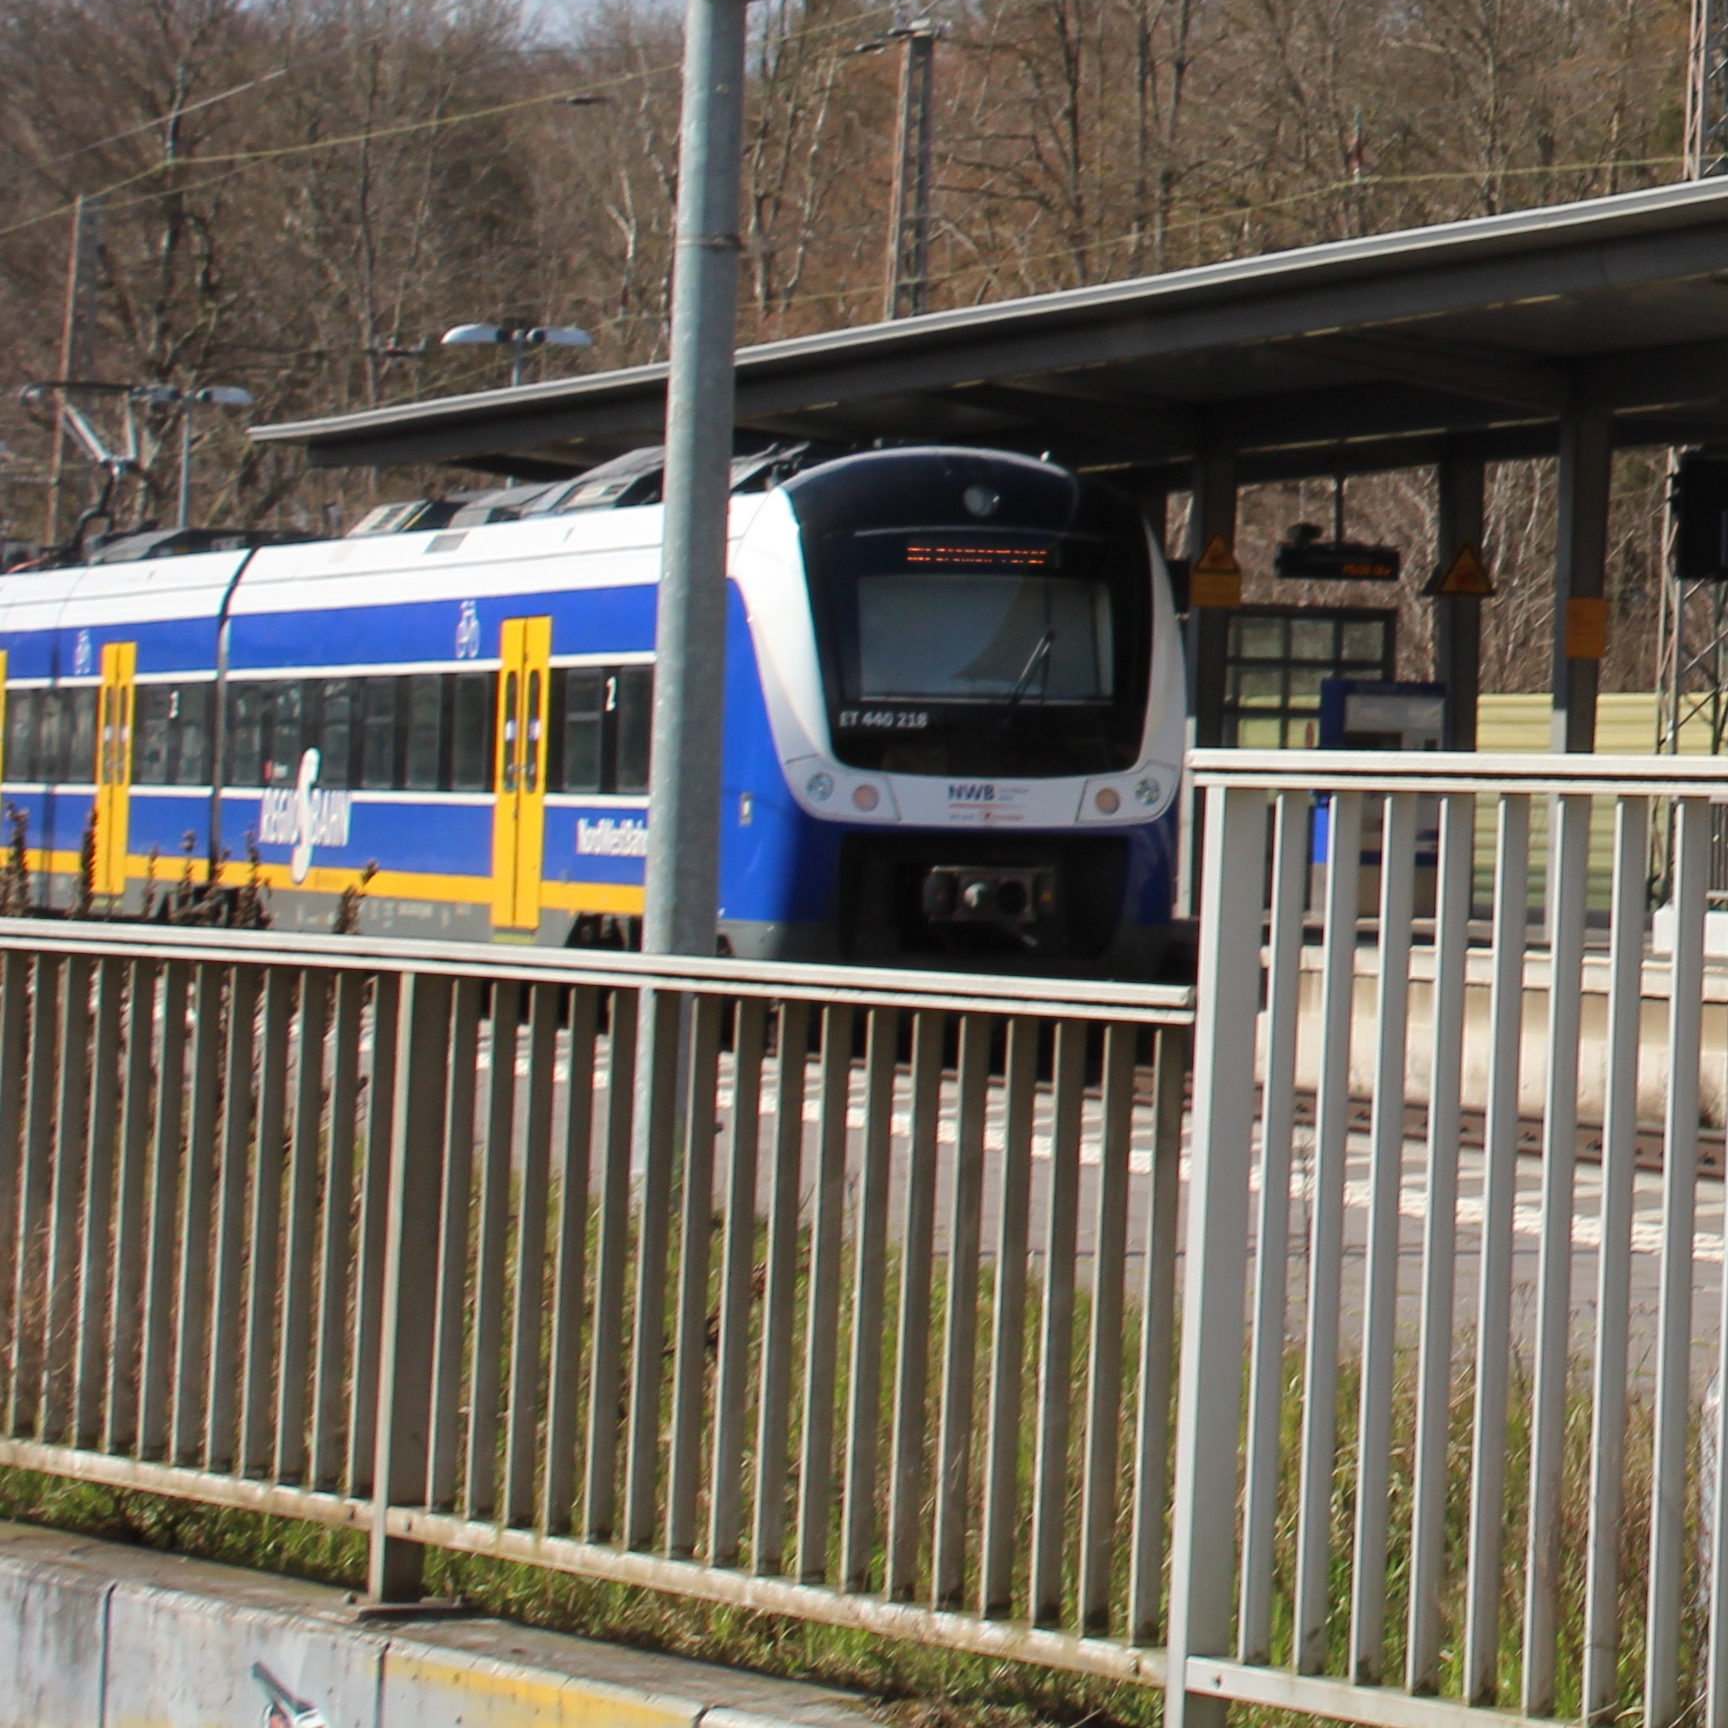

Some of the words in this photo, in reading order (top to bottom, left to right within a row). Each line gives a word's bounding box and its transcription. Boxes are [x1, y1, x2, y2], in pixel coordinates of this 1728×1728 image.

[605, 675, 617, 712] 2
[839, 710, 859, 728] ET
[861, 710, 895, 728] 440
[897, 710, 929, 729] 218
[947, 783, 995, 801] NWB
